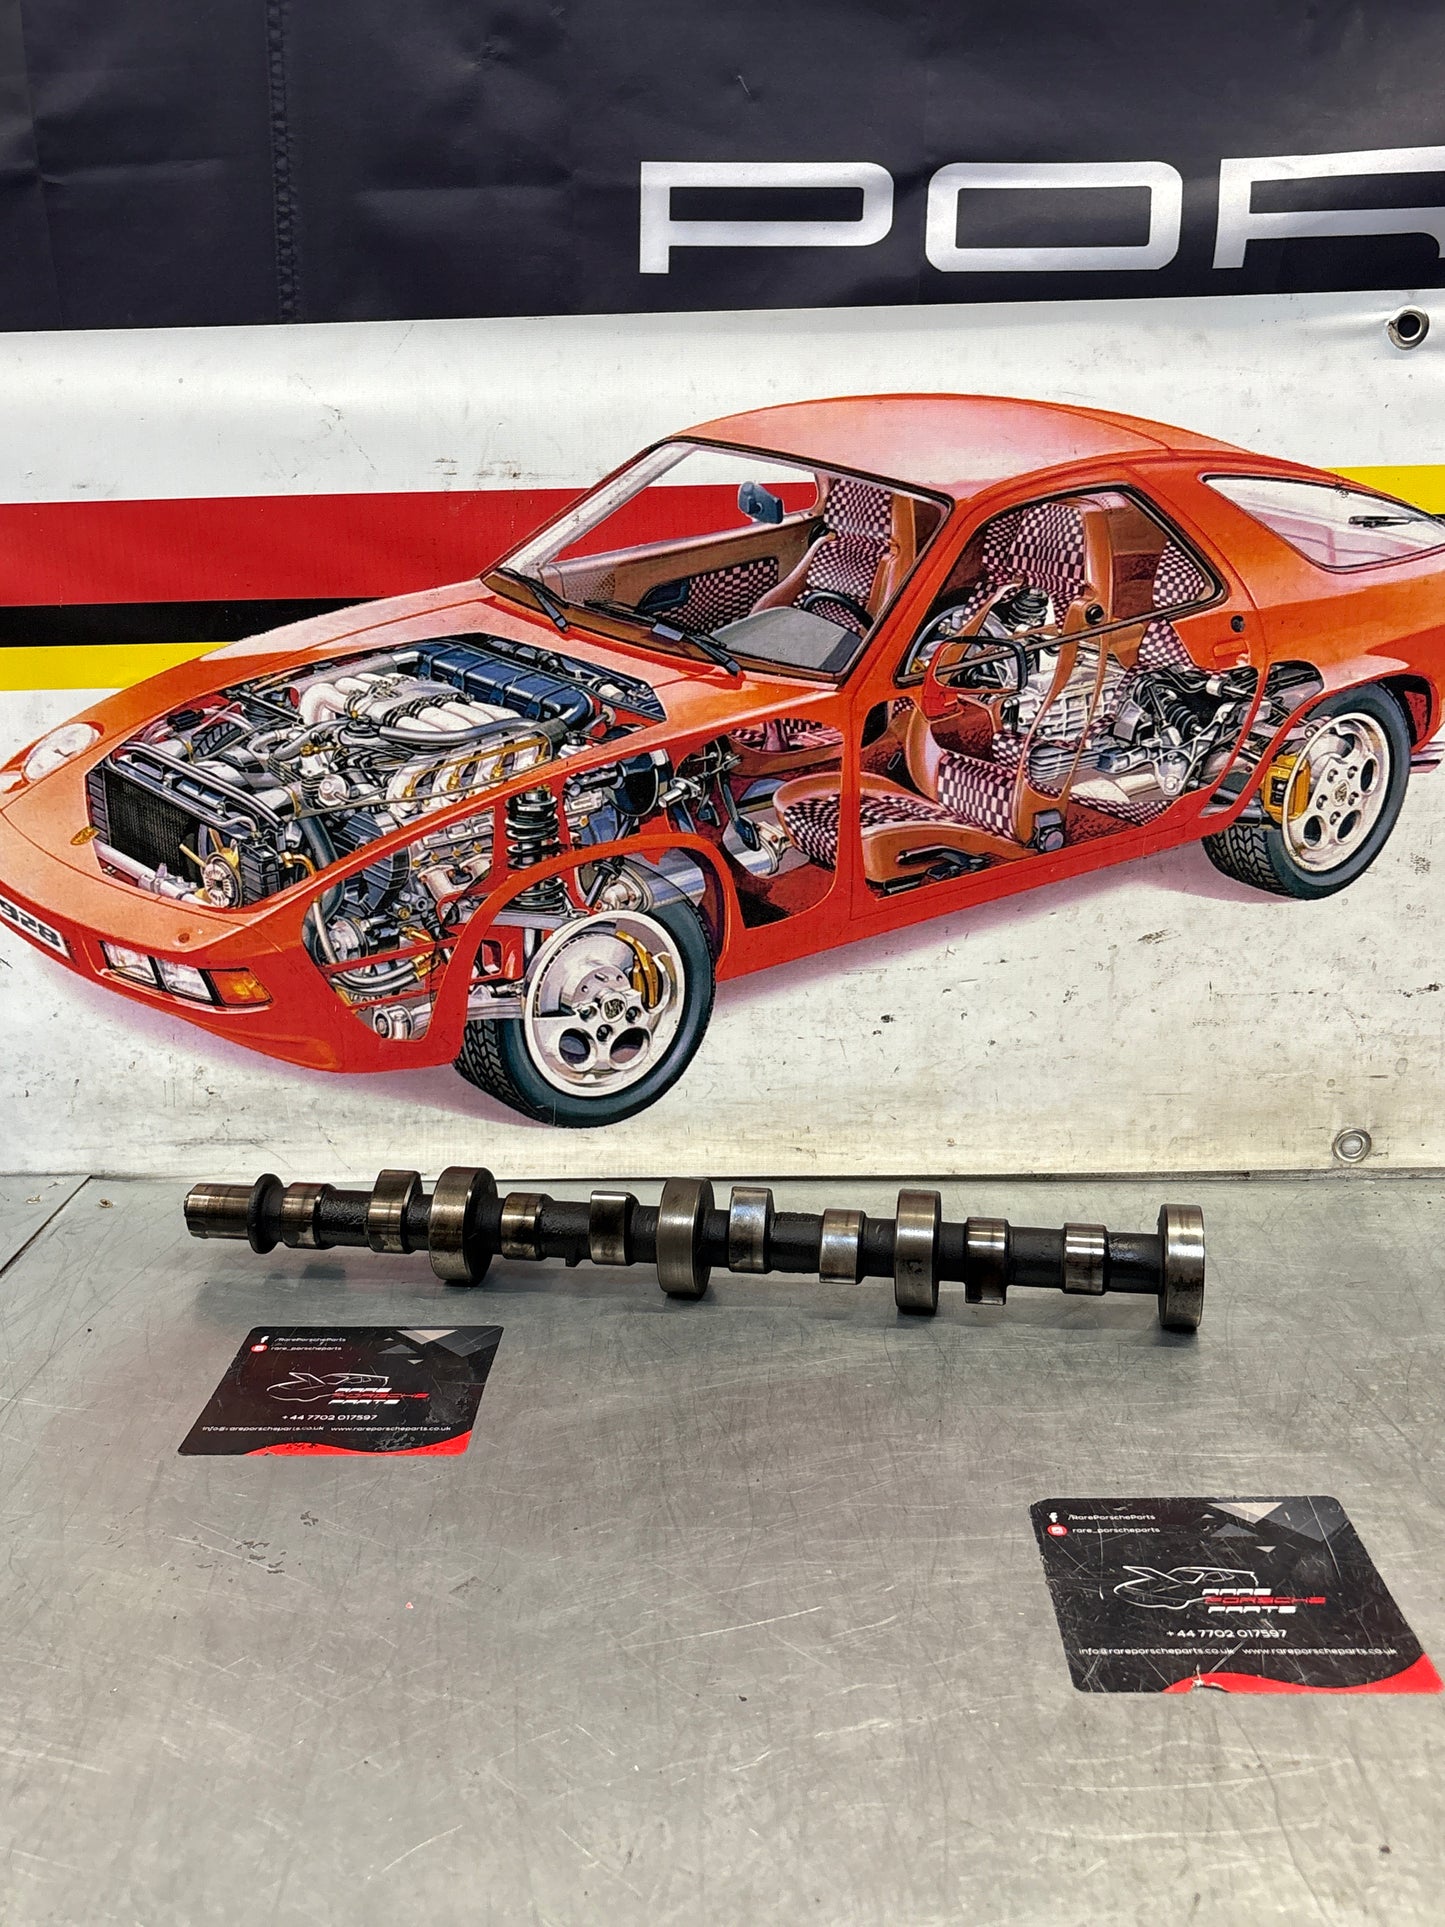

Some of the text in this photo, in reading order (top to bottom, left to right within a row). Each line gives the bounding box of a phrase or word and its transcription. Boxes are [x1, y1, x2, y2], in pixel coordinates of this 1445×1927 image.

[0, 899, 61, 947] 928
[1198, 1629, 1235, 1638] 7702
[1237, 1629, 1288, 1638] 017597
[1079, 1647, 1398, 1655] info@rareporscheparts.co.uk www.rareporscheparts.co.uk
